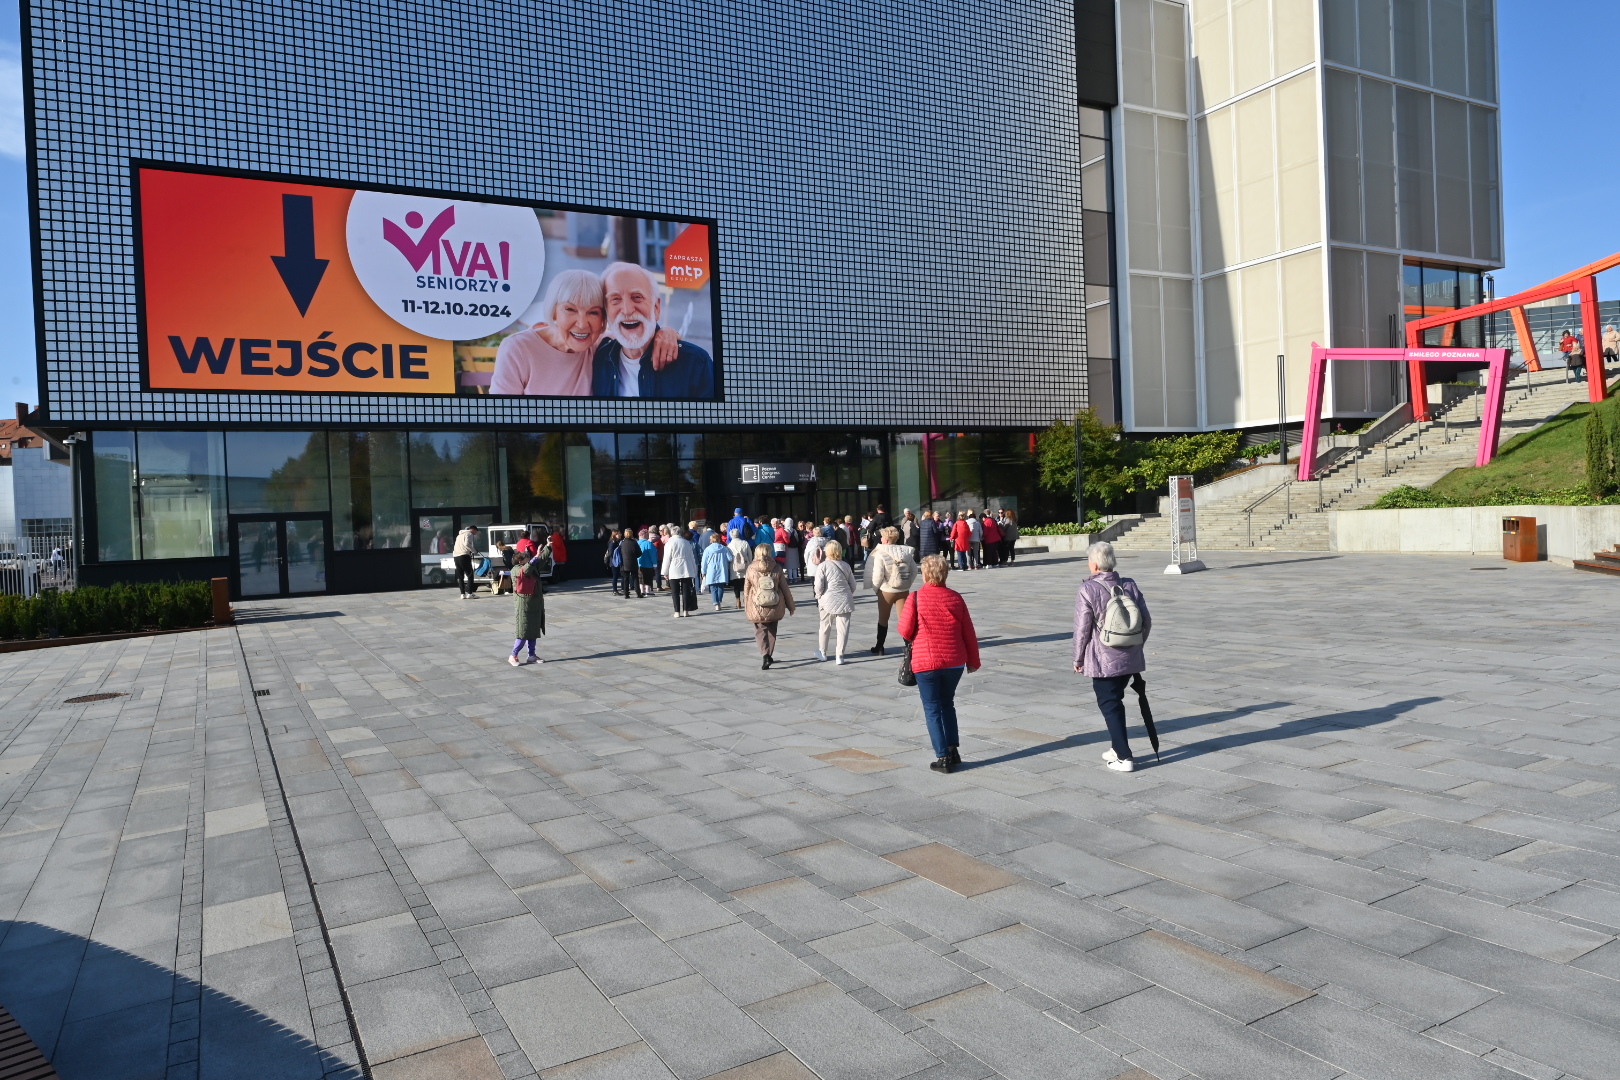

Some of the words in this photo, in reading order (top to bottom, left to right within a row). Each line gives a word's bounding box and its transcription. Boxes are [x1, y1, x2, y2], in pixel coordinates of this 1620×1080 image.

[383, 205, 511, 292] VIVA!
[669, 254, 703, 262] ZAPRASZA
[670, 265, 703, 279] mtp
[416, 275, 499, 293] SENIORZY
[401, 299, 512, 318] 11-12.10.2024
[167, 331, 429, 379] WEJŚCIE
[809, 464, 817, 481] A
